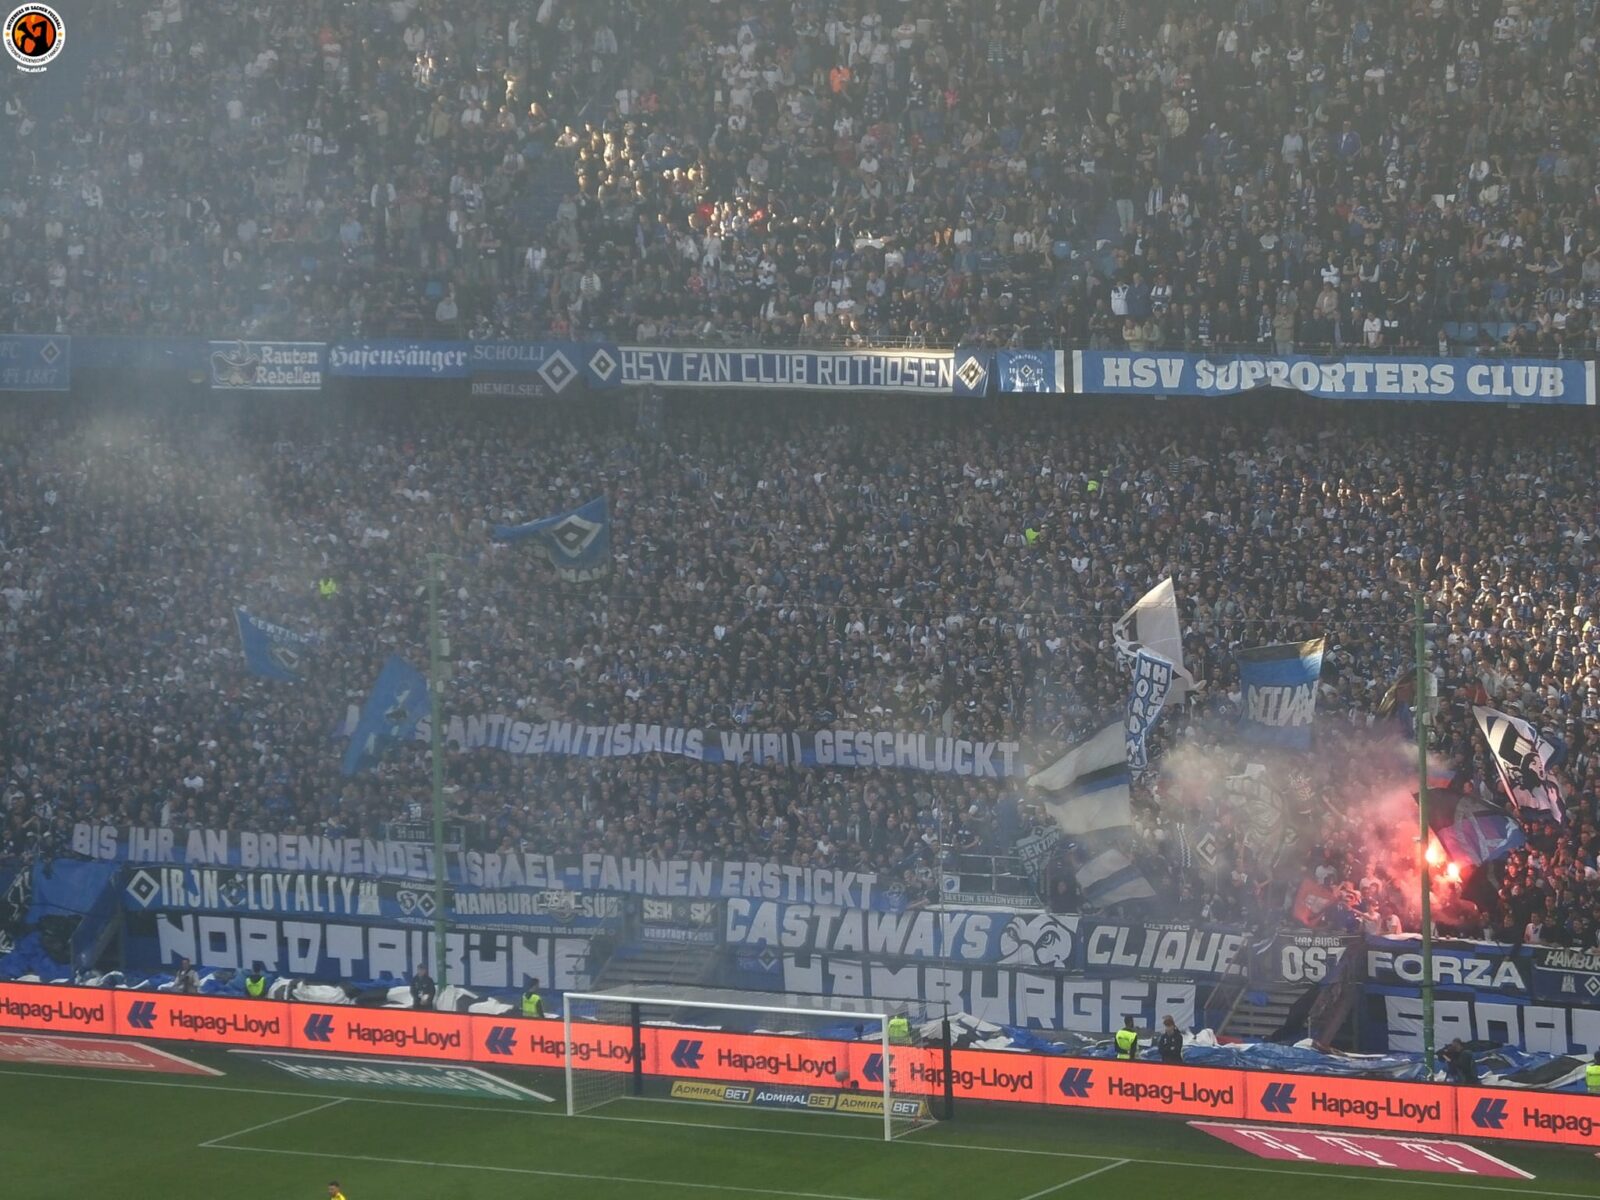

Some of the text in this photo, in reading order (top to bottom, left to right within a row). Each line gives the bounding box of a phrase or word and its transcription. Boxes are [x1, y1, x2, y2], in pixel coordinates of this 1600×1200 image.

[260, 346, 318, 364] Rauten
[473, 345, 545, 361] SCHOLLI
[255, 366, 321, 384] Rebellen
[621, 350, 955, 388] HSV FAN CLUB ROTHOSEN
[1103, 357, 1566, 397] HSV SUPPORTERS CLUB
[814, 730, 1019, 777] GESCHLUCKT
[73, 824, 118, 860] BIS
[128, 827, 174, 862] IHR
[185, 828, 228, 865] AN
[721, 861, 877, 910] ERSTICKT
[248, 873, 355, 916] LOYALTY
[726, 897, 990, 958] CASTAWAYS
[156, 913, 591, 991] NORDTRIBÜNE
[1367, 950, 1525, 989] FORZA
[0, 999, 104, 1023] Hapag-Lloyd
[170, 1009, 280, 1036] Hapag-Lloyd
[347, 1021, 461, 1050] Hapag-Lloyd
[718, 1049, 837, 1078] Hapag-Lloyd
[1108, 1076, 1234, 1105] Hapag-Lloyd
[839, 1098, 918, 1114] ADMIRABET
[1312, 1091, 1441, 1123] Hapag-Lloyd
